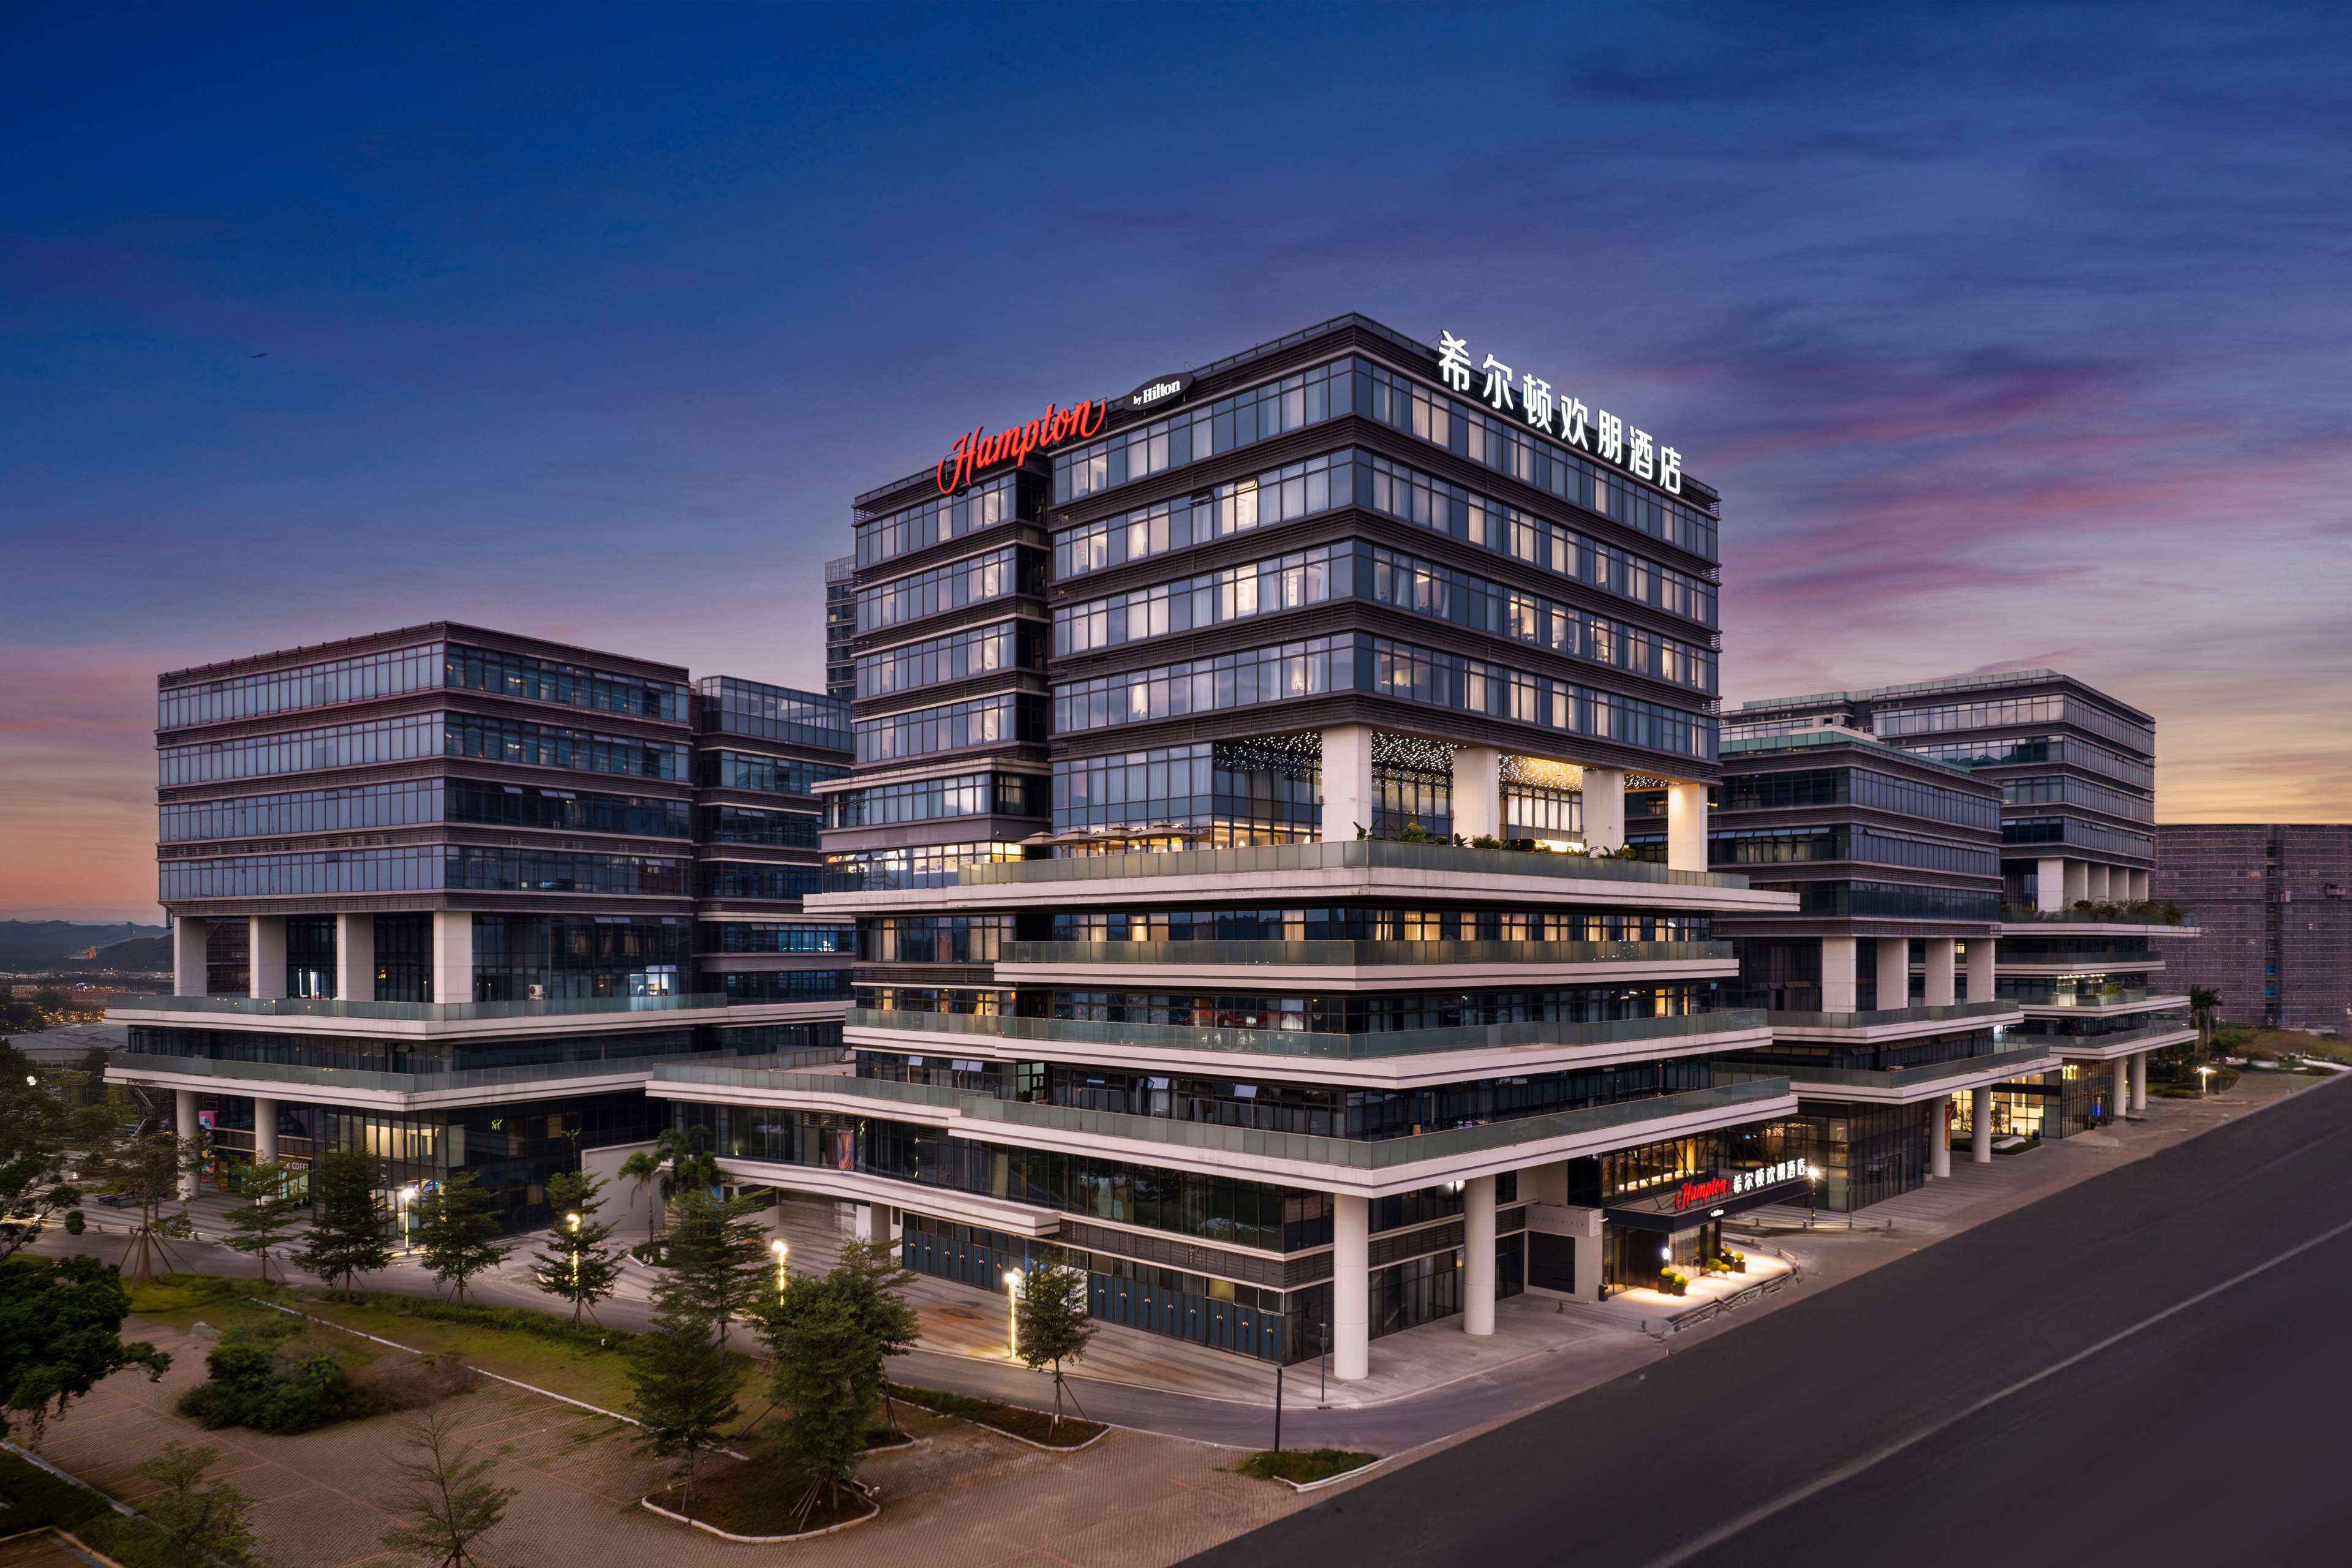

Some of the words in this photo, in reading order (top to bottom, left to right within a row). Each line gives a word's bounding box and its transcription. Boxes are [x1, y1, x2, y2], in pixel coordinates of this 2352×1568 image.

[1133, 396, 1142, 405] by
[1143, 380, 1181, 404] Hilton
[1438, 329, 1682, 494] 希尔顿欢朋酒店
[937, 399, 1106, 494] Hampton
[1675, 1177, 1731, 1211] Hampton
[1733, 1158, 1806, 1194] 希尔顿欢朋酒店
